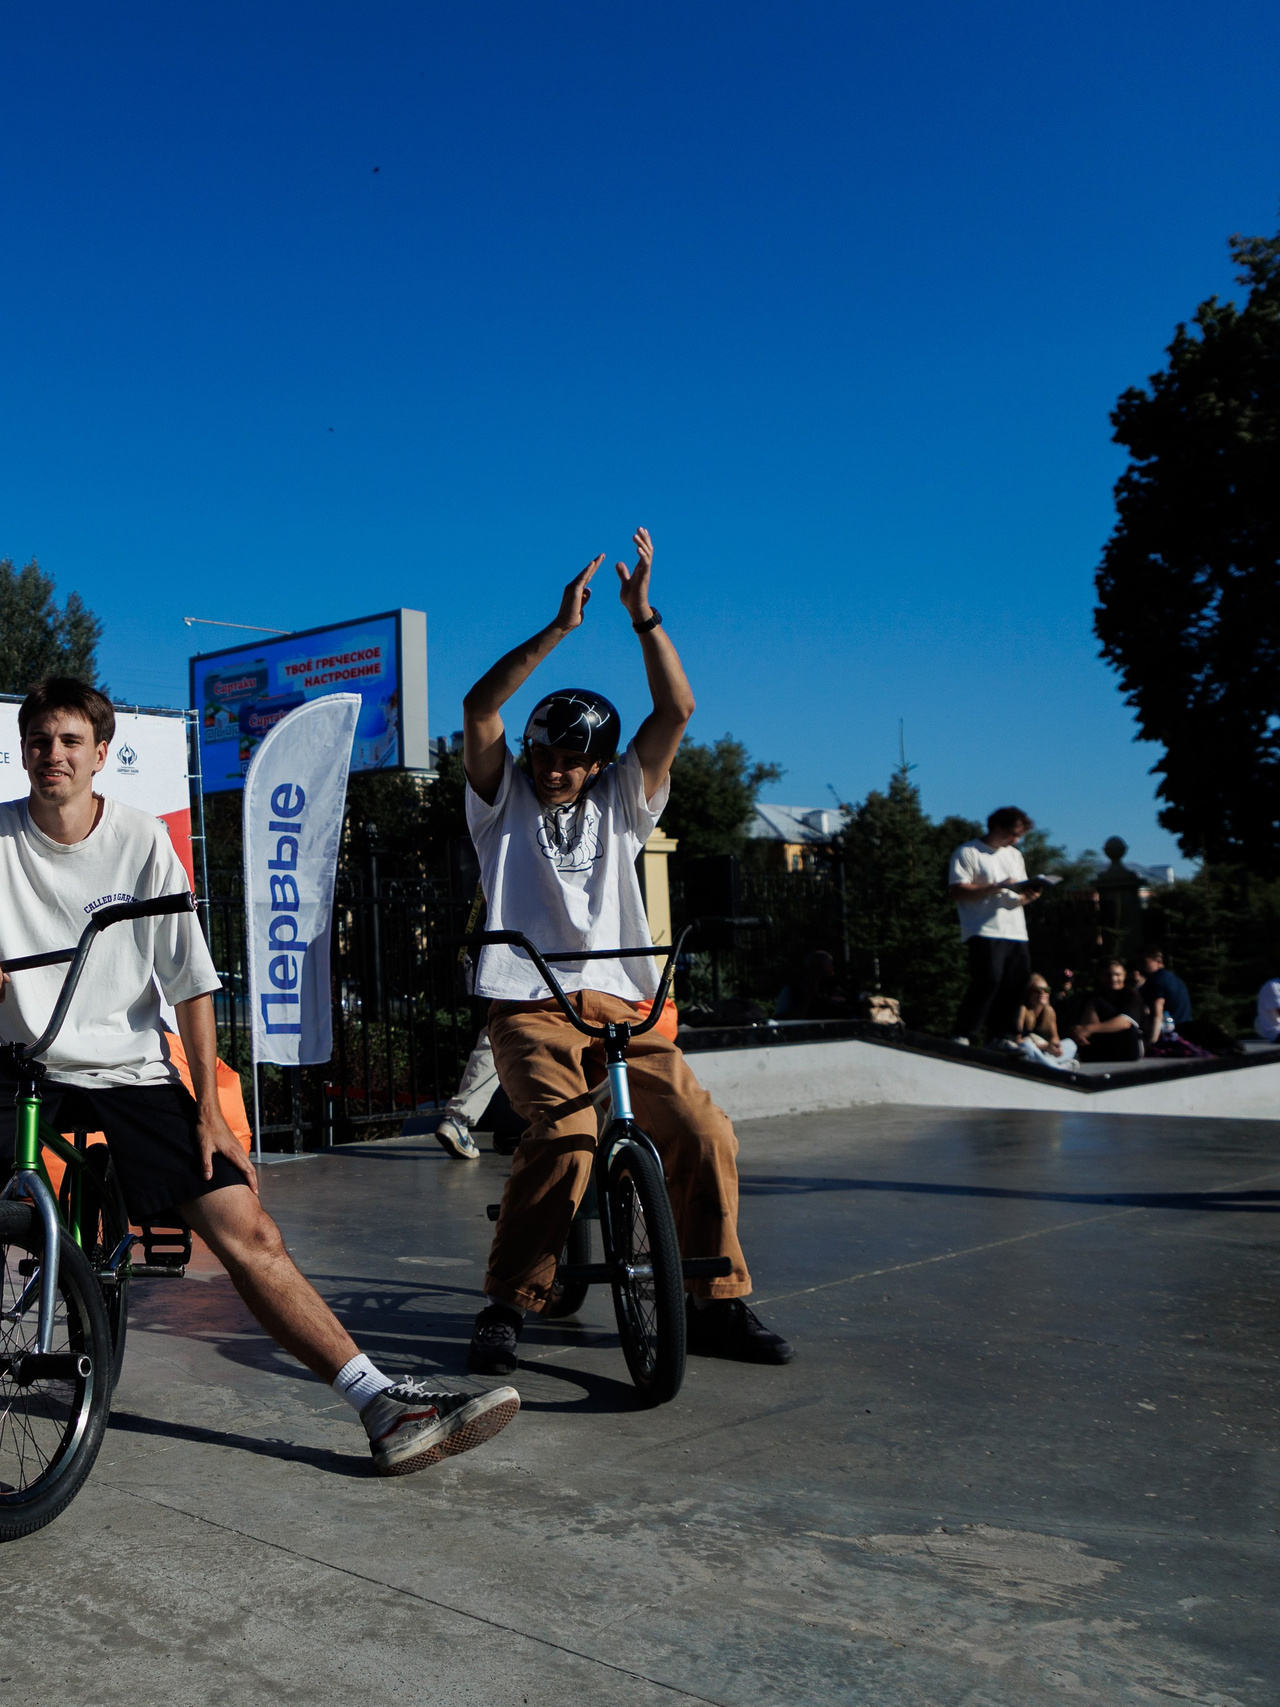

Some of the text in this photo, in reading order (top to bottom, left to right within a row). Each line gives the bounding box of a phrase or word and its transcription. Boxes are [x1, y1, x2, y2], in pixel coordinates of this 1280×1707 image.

[285, 646, 381, 677] ТВОЁ ГРЕЧЕСКОЕ
[214, 677, 257, 695] Сиртаки
[304, 662, 381, 688] НАСТРОЕНИЕ
[83, 895, 113, 914] CALLED
[260, 782, 308, 1035] Первые
